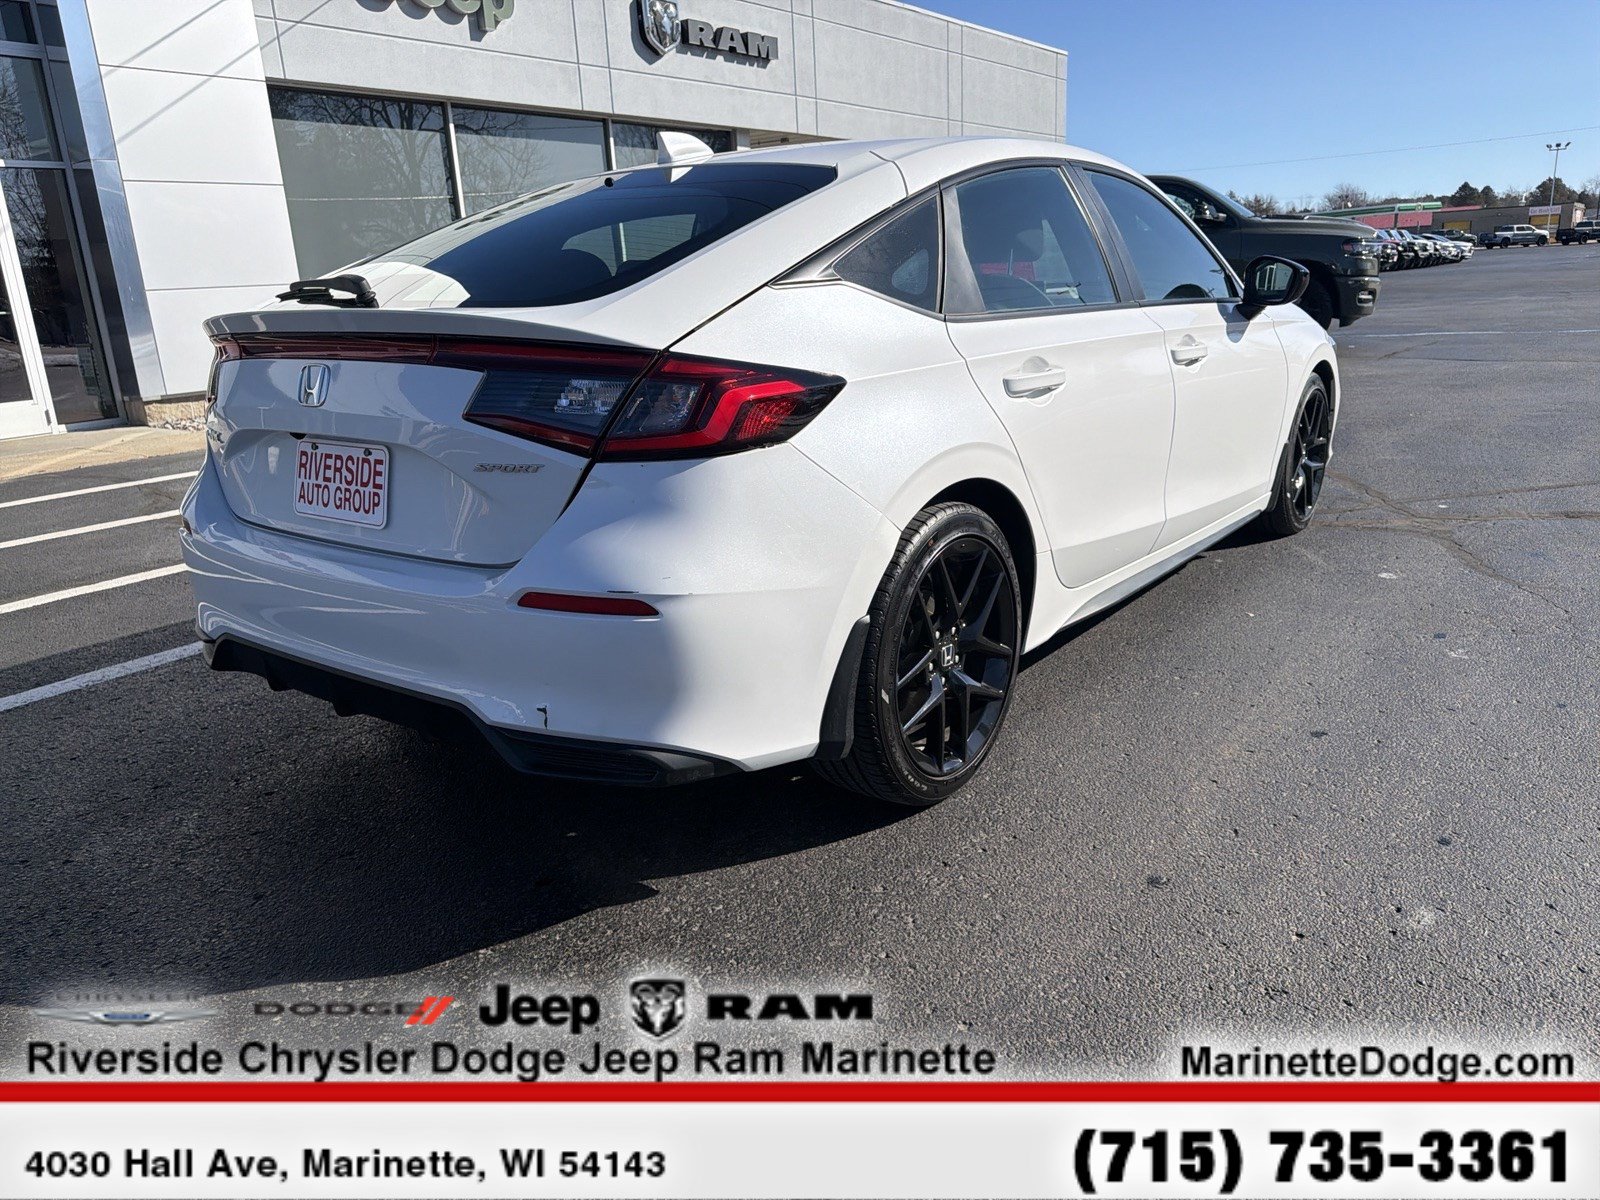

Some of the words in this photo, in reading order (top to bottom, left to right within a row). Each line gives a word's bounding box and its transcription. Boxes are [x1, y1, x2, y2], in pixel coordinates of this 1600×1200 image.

[681, 18, 779, 60] RAM
[298, 450, 384, 490] RIVERSIDE
[474, 462, 546, 474] SPORT
[298, 481, 331, 508] AUTO
[333, 485, 381, 515] GROUP
